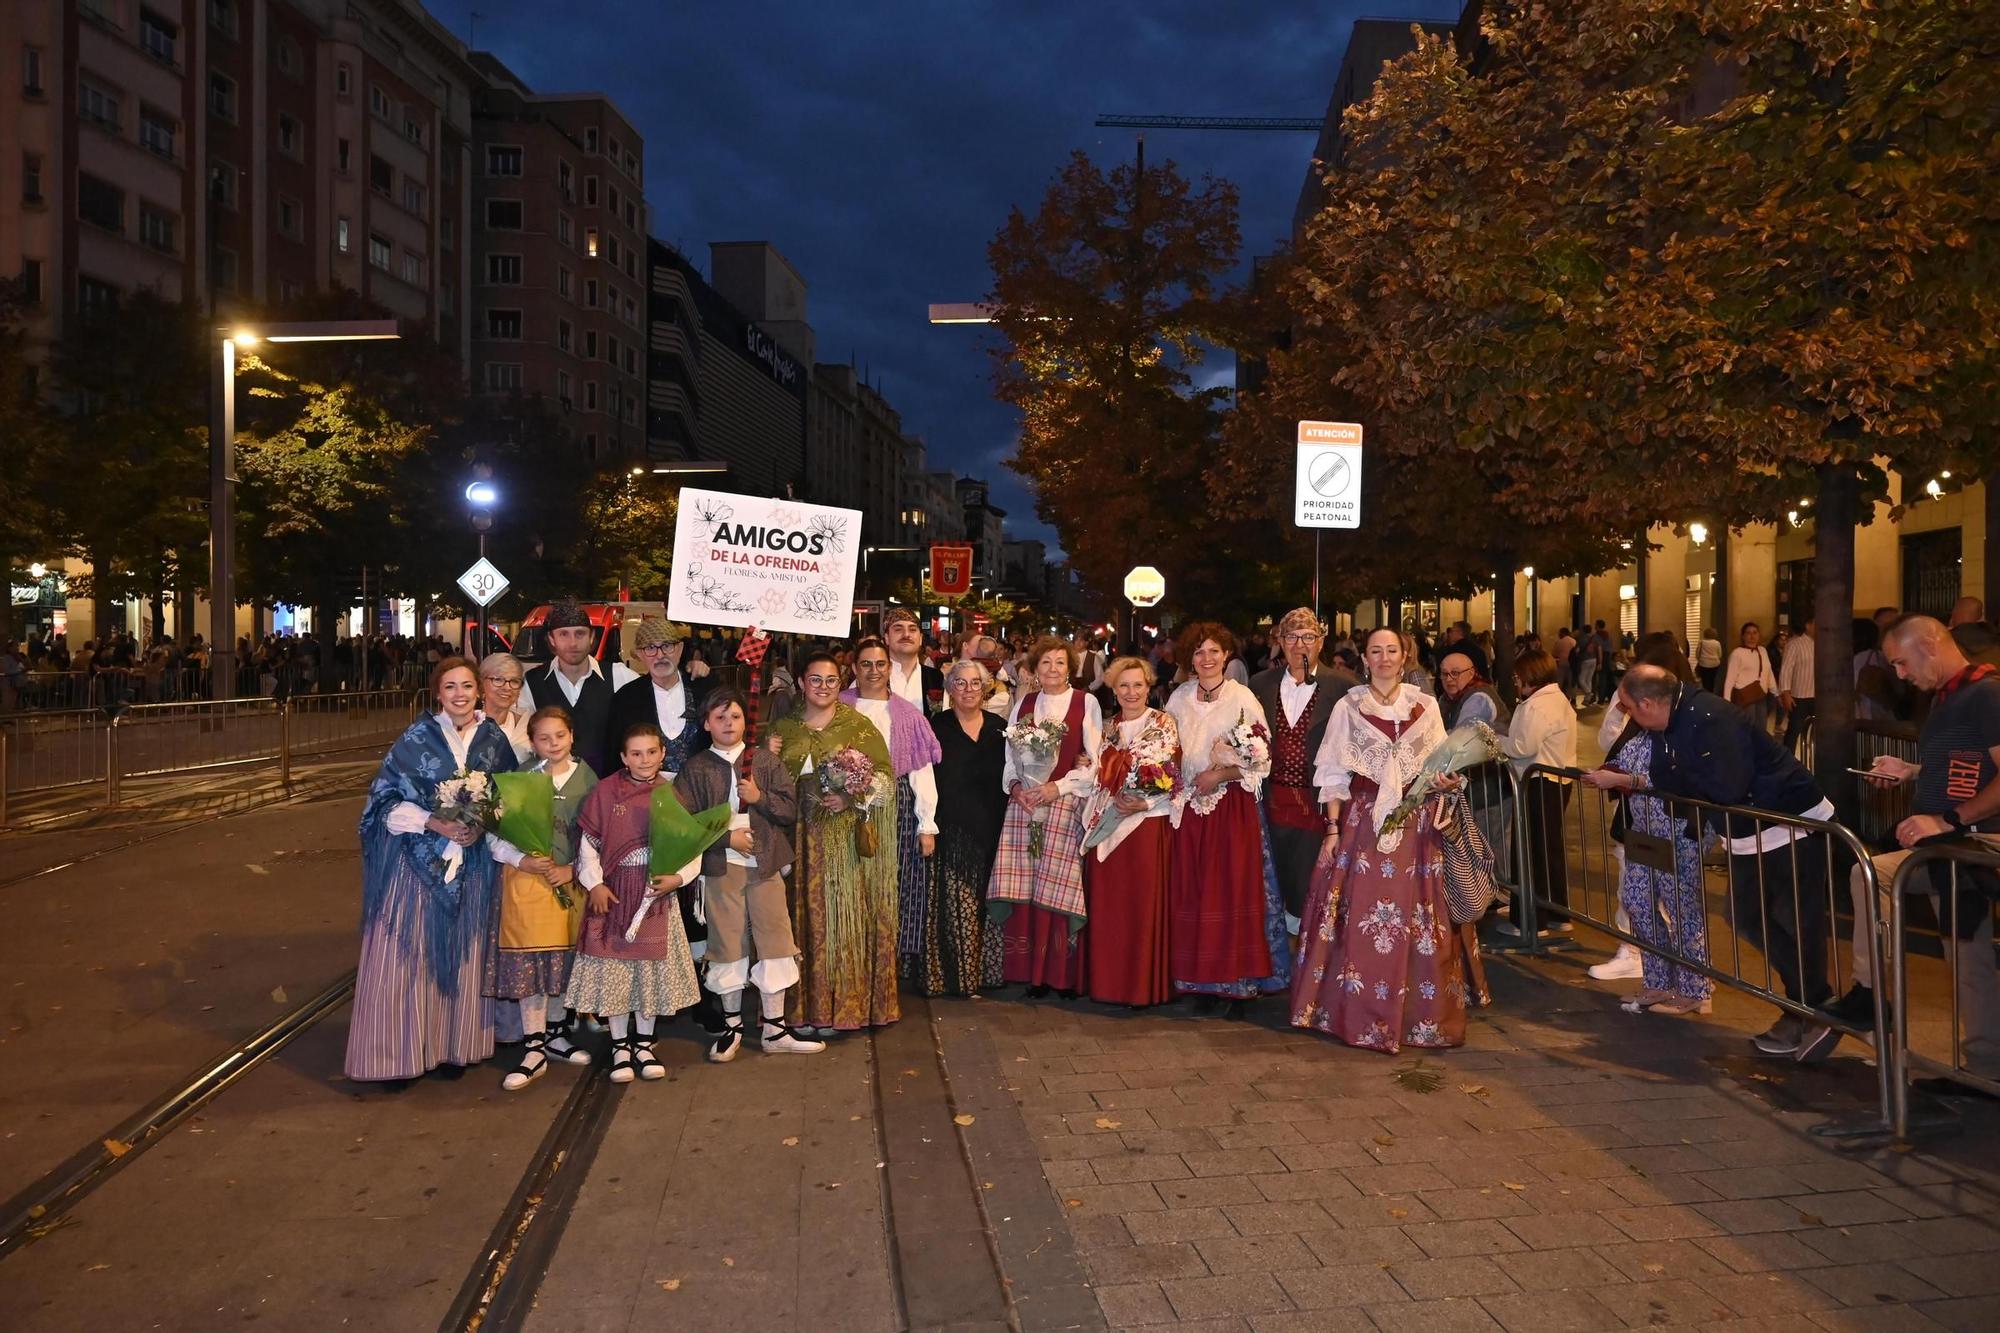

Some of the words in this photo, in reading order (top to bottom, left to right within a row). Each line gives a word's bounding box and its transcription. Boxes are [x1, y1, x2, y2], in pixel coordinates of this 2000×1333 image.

[1306, 428, 1355, 438] ATENCIÓN
[1303, 500, 1354, 510] PRIORIDAD
[1303, 512, 1352, 522] PEATONAL
[713, 522, 823, 555] AMIGOS
[711, 549, 729, 561] DE
[732, 552, 750, 564] LA
[754, 555, 820, 573] OFRENDA
[472, 573, 494, 590] 30
[724, 567, 758, 578] FLORES
[758, 571, 767, 579] &
[770, 573, 807, 583] AMISTAD
[1947, 760, 1980, 797] ZERO
